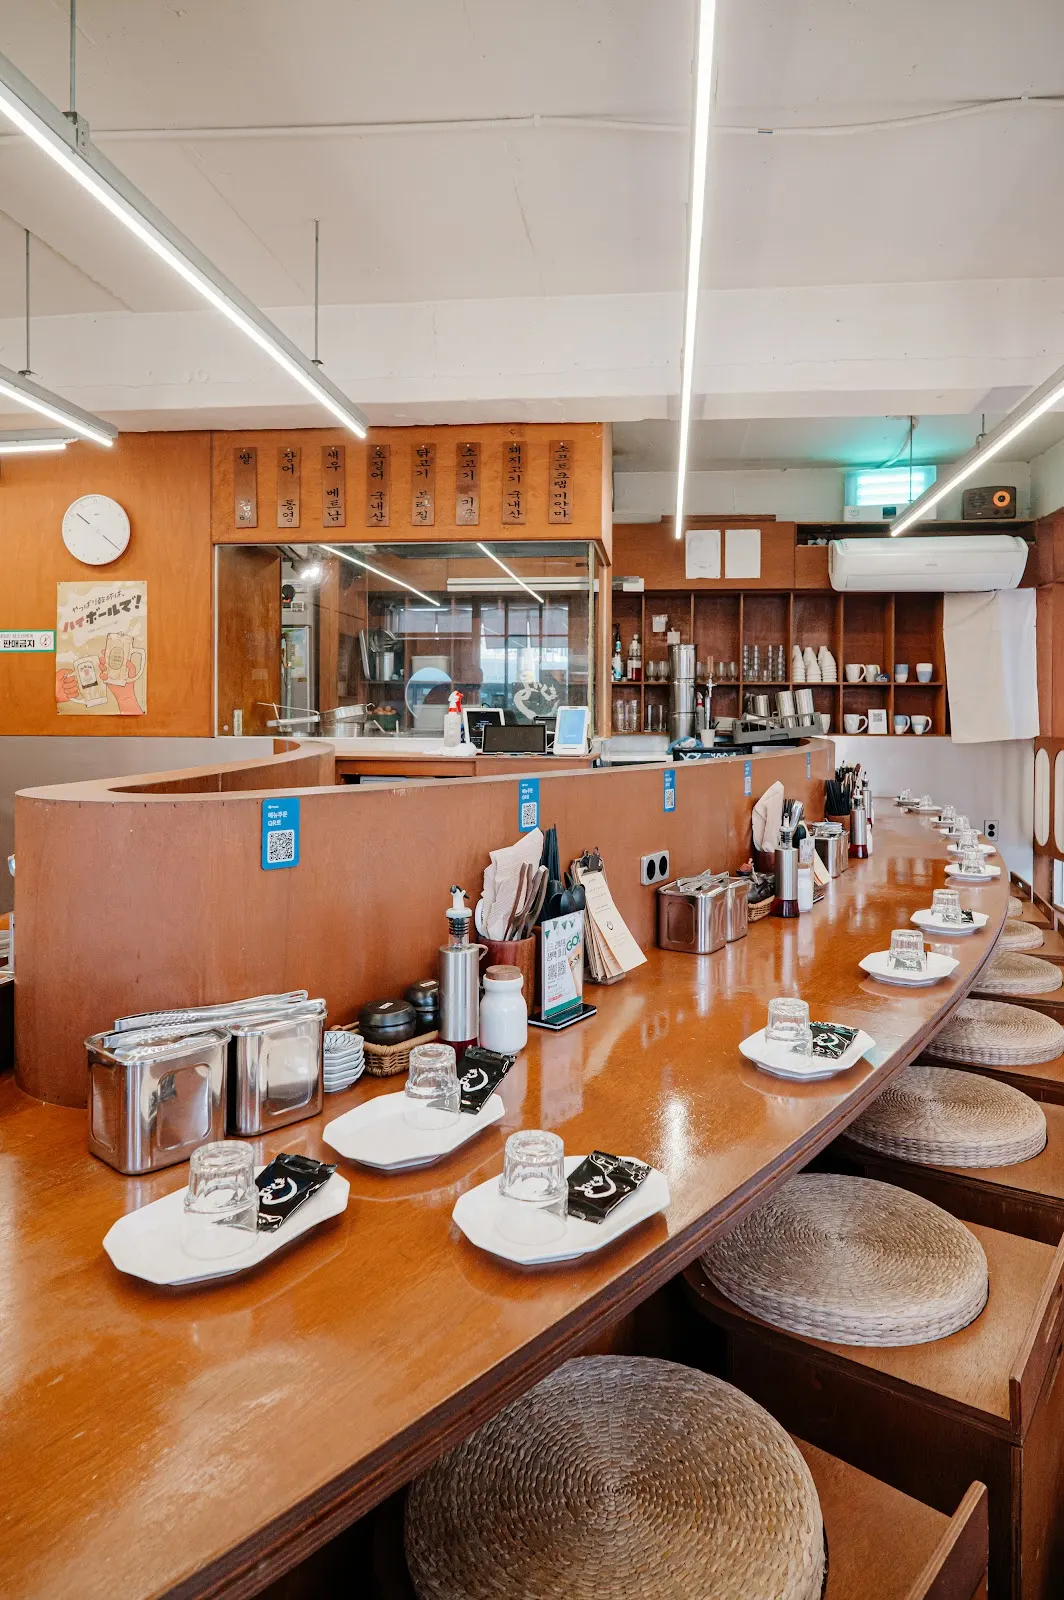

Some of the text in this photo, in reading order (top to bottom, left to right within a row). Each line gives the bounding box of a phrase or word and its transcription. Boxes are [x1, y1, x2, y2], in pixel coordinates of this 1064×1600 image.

[239, 452, 252, 465] 쌀
[281, 451, 297, 523] 장어 통영
[326, 449, 342, 522] 새우 베트남
[370, 450, 386, 522] 오징어 국내산
[415, 447, 431, 521] 닭고기 브라질
[461, 447, 477, 520] 소고기 미국
[507, 445, 524, 520] 돼지고기 국내산
[3, 639, 35, 649] 판매금지
[566, 932, 581, 952] GO!
